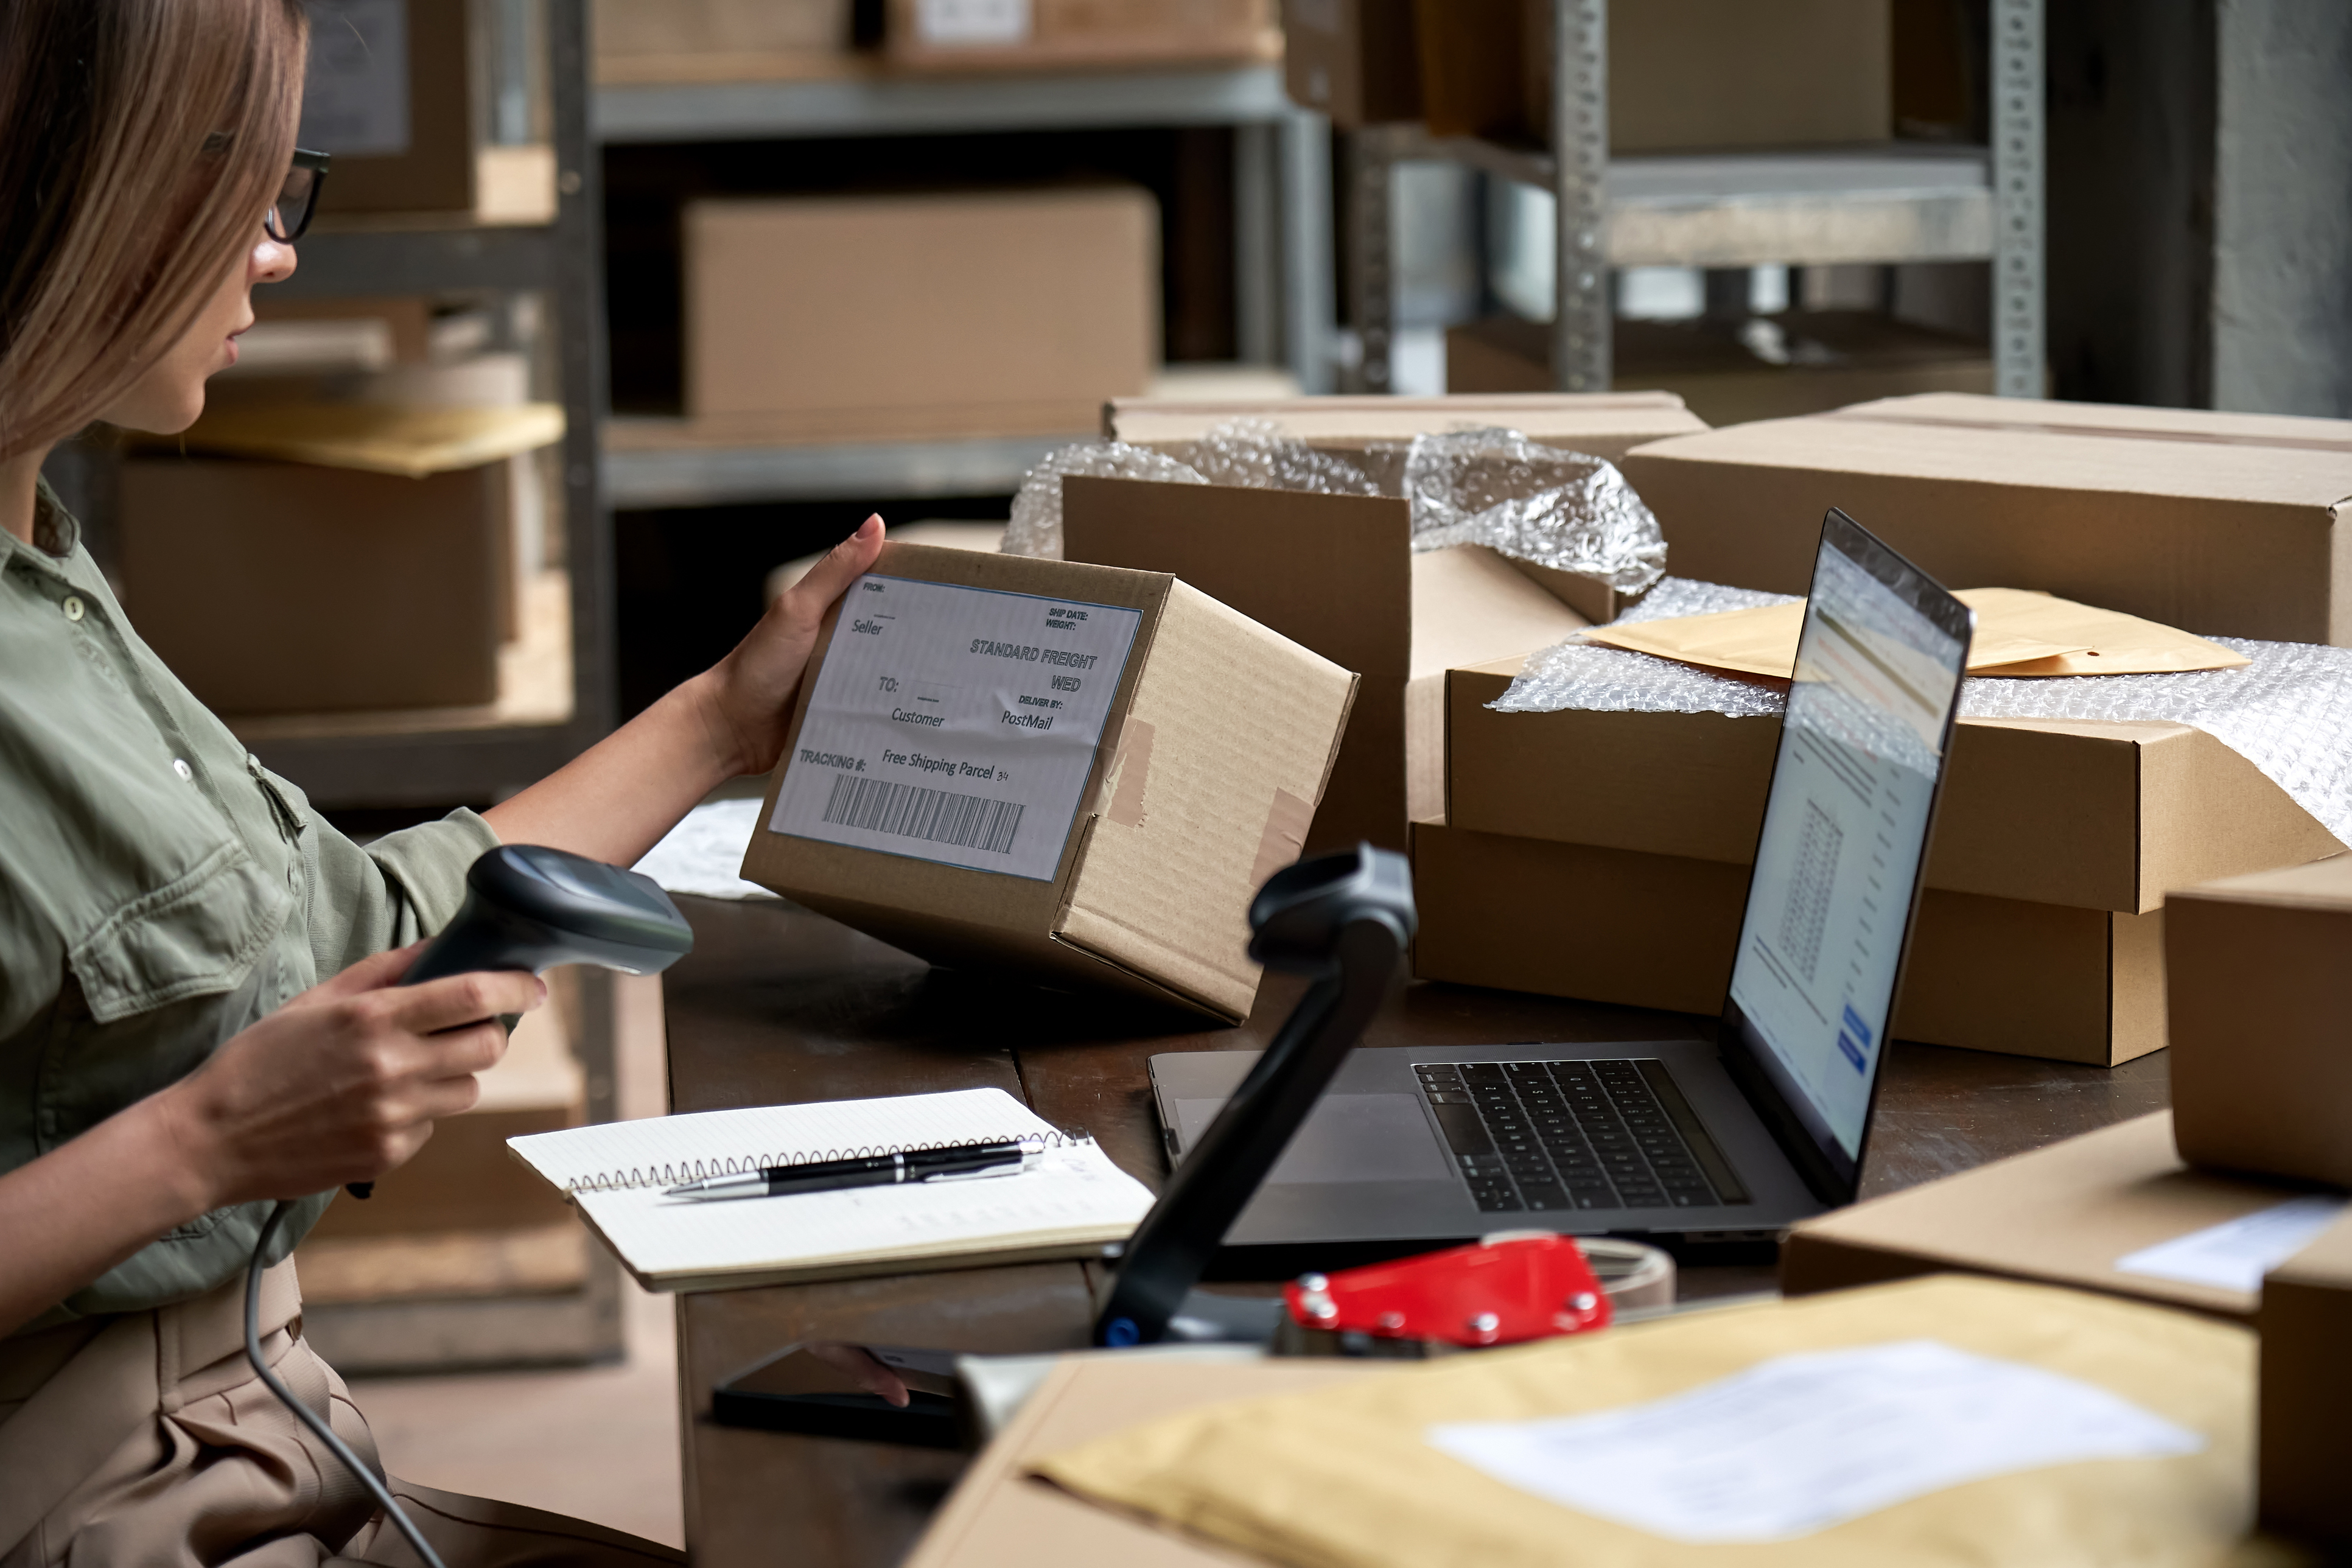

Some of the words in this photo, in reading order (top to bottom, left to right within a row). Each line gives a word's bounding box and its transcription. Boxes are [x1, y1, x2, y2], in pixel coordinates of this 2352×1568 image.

[863, 582, 885, 592] FROM:
[1049, 608, 1066, 618] SHIP
[1066, 610, 1088, 620] DATE:
[852, 619, 883, 635] Seller
[1046, 618, 1076, 631] WEIGHT:
[970, 639, 1040, 662] STANDARD
[1040, 649, 1097, 670] FREIGHT
[878, 676, 899, 693] TO:
[1051, 675, 1081, 692] WED
[1018, 695, 1049, 707] DELIVER
[1049, 699, 1063, 709] BY:
[892, 708, 945, 727] Customer
[1001, 710, 1053, 730] PostMail
[800, 749, 854, 769] TRACKING
[883, 749, 906, 765] Free
[909, 753, 957, 776] Shipping
[959, 761, 995, 779] Parcel
